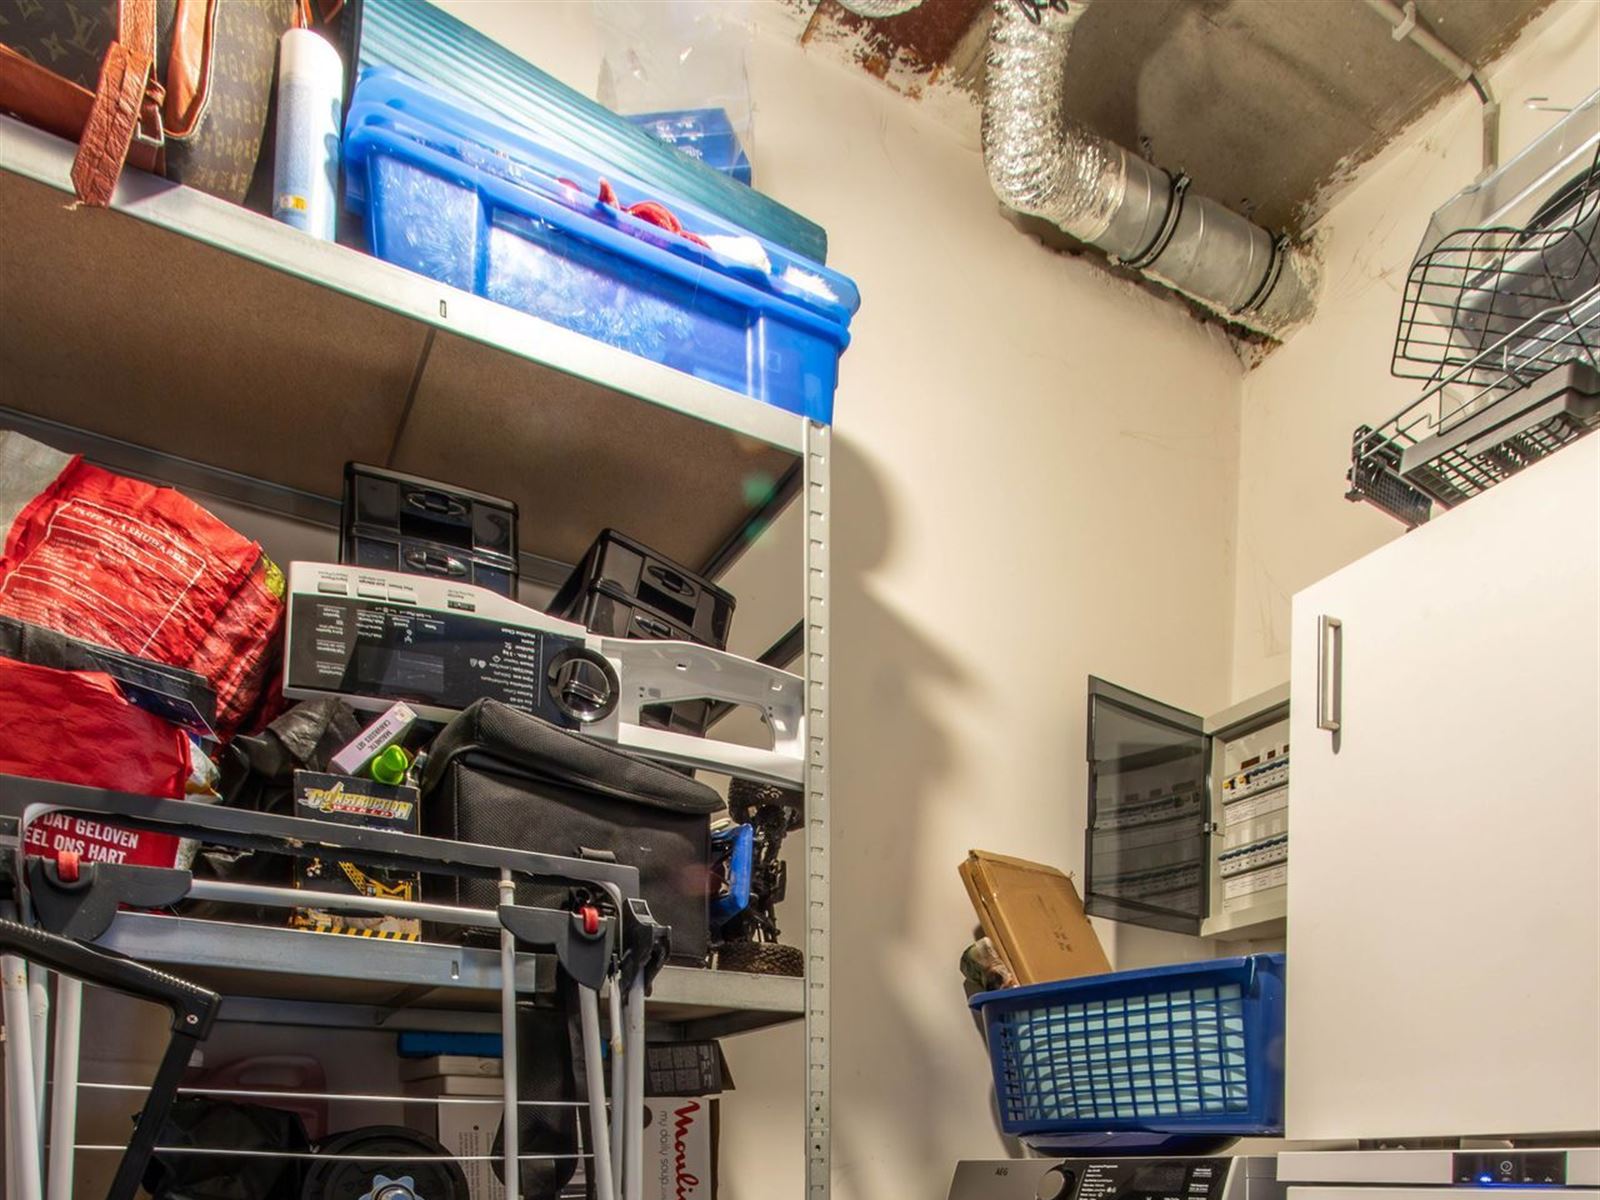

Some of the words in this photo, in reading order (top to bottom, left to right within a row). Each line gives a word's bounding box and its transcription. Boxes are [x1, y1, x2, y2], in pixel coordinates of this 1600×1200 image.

[43, 812, 71, 831] DAT
[75, 818, 139, 849] GELOVEN
[53, 834, 85, 856] ONS
[87, 844, 127, 865] HART
[995, 1167, 1008, 1176] AEG
